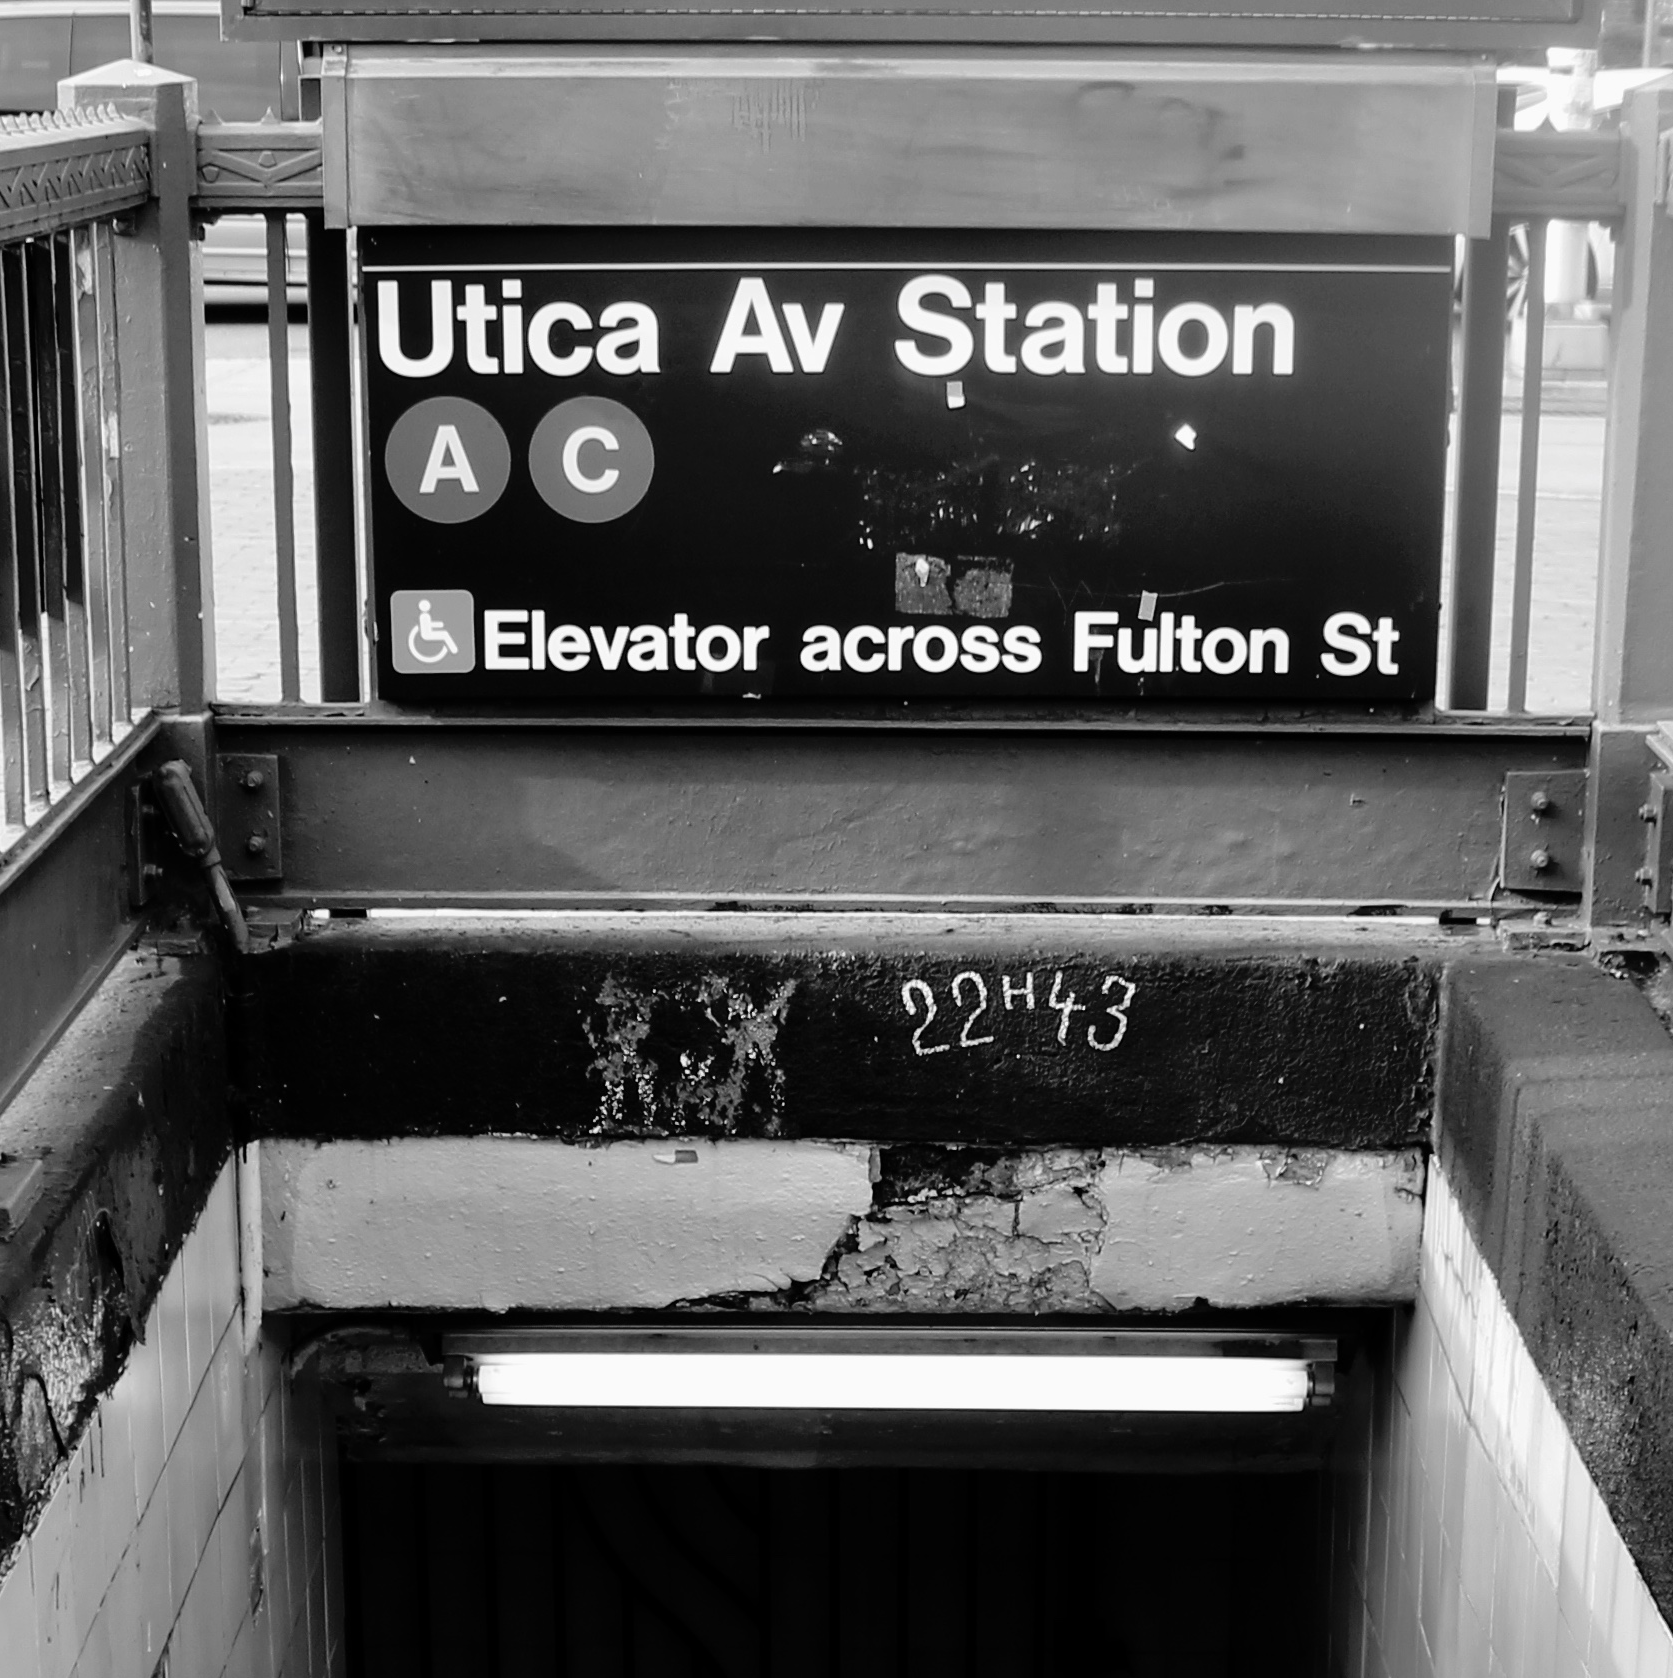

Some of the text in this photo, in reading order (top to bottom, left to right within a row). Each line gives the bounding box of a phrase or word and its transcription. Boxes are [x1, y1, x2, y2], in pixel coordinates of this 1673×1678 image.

[377, 274, 1295, 378] Utica Av Station
[419, 425, 620, 494] A C
[484, 605, 1400, 676] Elevator across Fulton St
